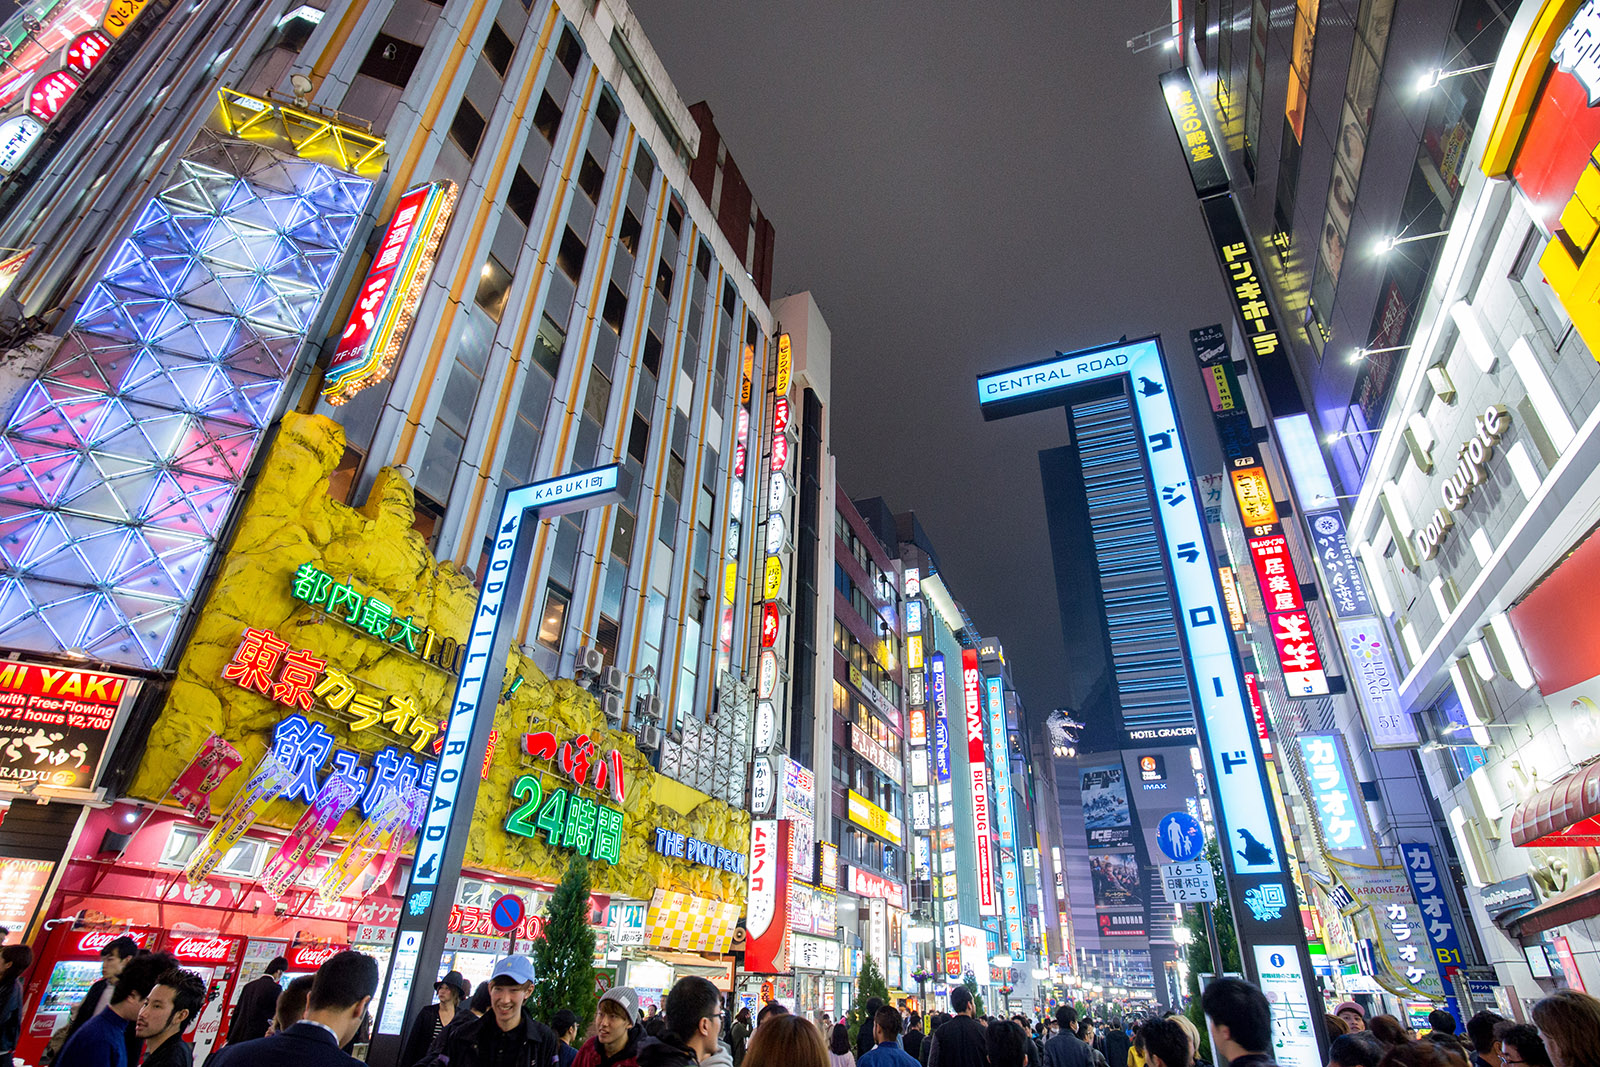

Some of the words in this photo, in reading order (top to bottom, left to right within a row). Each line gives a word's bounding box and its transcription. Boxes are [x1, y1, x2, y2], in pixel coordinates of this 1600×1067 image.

[987, 367, 1071, 395] CENTRAL
[1076, 353, 1128, 375] ROAD
[1415, 507, 1450, 561] Don
[1441, 404, 1503, 512] Quijote
[1254, 524, 1273, 536] 6F
[1148, 428, 1248, 774] ゴジラロード
[1265, 558, 1296, 611] 居楽屋
[292, 562, 421, 654] 都内最大
[456, 538, 514, 717] GODZILLA
[41, 668, 125, 702] YAKI
[1361, 661, 1384, 703] STAGE
[1372, 660, 1394, 695] IDOL
[24, 710, 65, 724] hours
[66, 714, 111, 730] ¥2,700
[28, 696, 115, 719] Free-Flowing
[964, 669, 983, 742] SHIDAX
[1378, 714, 1401, 729] 5F
[1130, 729, 1158, 740] HOTEL
[1158, 727, 1197, 738] GRACERY
[271, 713, 438, 821] 飲み放
[524, 731, 625, 803] つぼ八
[973, 770, 984, 790] BIC
[426, 740, 467, 843] ROAD
[1306, 739, 1356, 844] カラオケ
[506, 773, 624, 865] 24時間
[975, 795, 987, 832] DRUG
[1091, 829, 1112, 840] ICE
[655, 826, 685, 858] THE
[752, 827, 768, 892] トラノコ
[1004, 871, 1020, 951] カラオケ館
[1407, 847, 1452, 943] カラオケ
[1112, 915, 1144, 925] MARUHAN
[174, 937, 232, 959] Coca-Cola
[1387, 903, 1426, 984] カラオケ
[1435, 947, 1461, 964] B1
